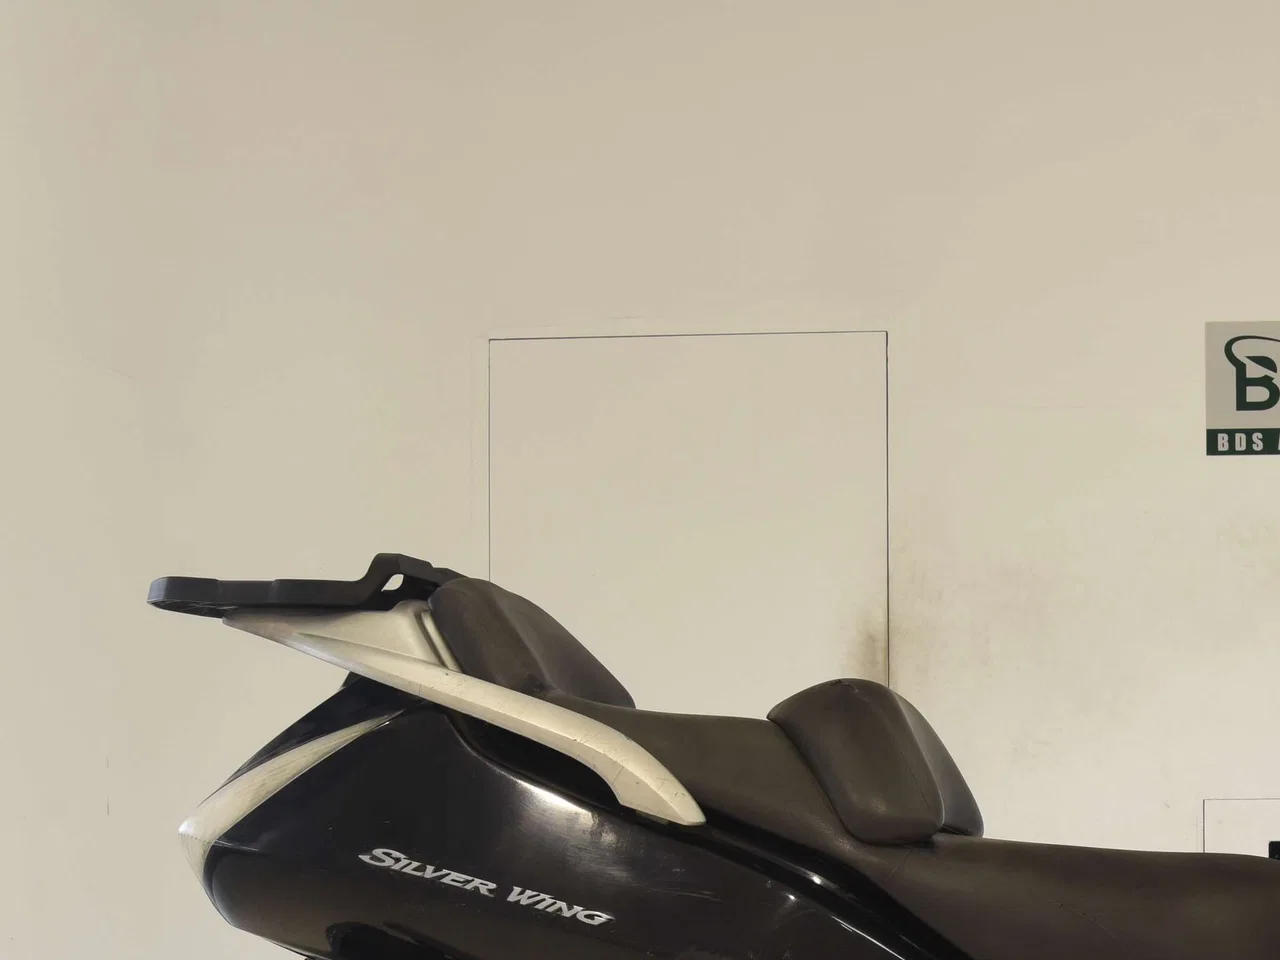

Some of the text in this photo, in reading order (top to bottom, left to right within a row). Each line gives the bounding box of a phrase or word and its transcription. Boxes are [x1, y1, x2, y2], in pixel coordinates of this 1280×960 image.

[1217, 432, 1264, 451] BDS
[358, 848, 616, 926] SILVER WING
